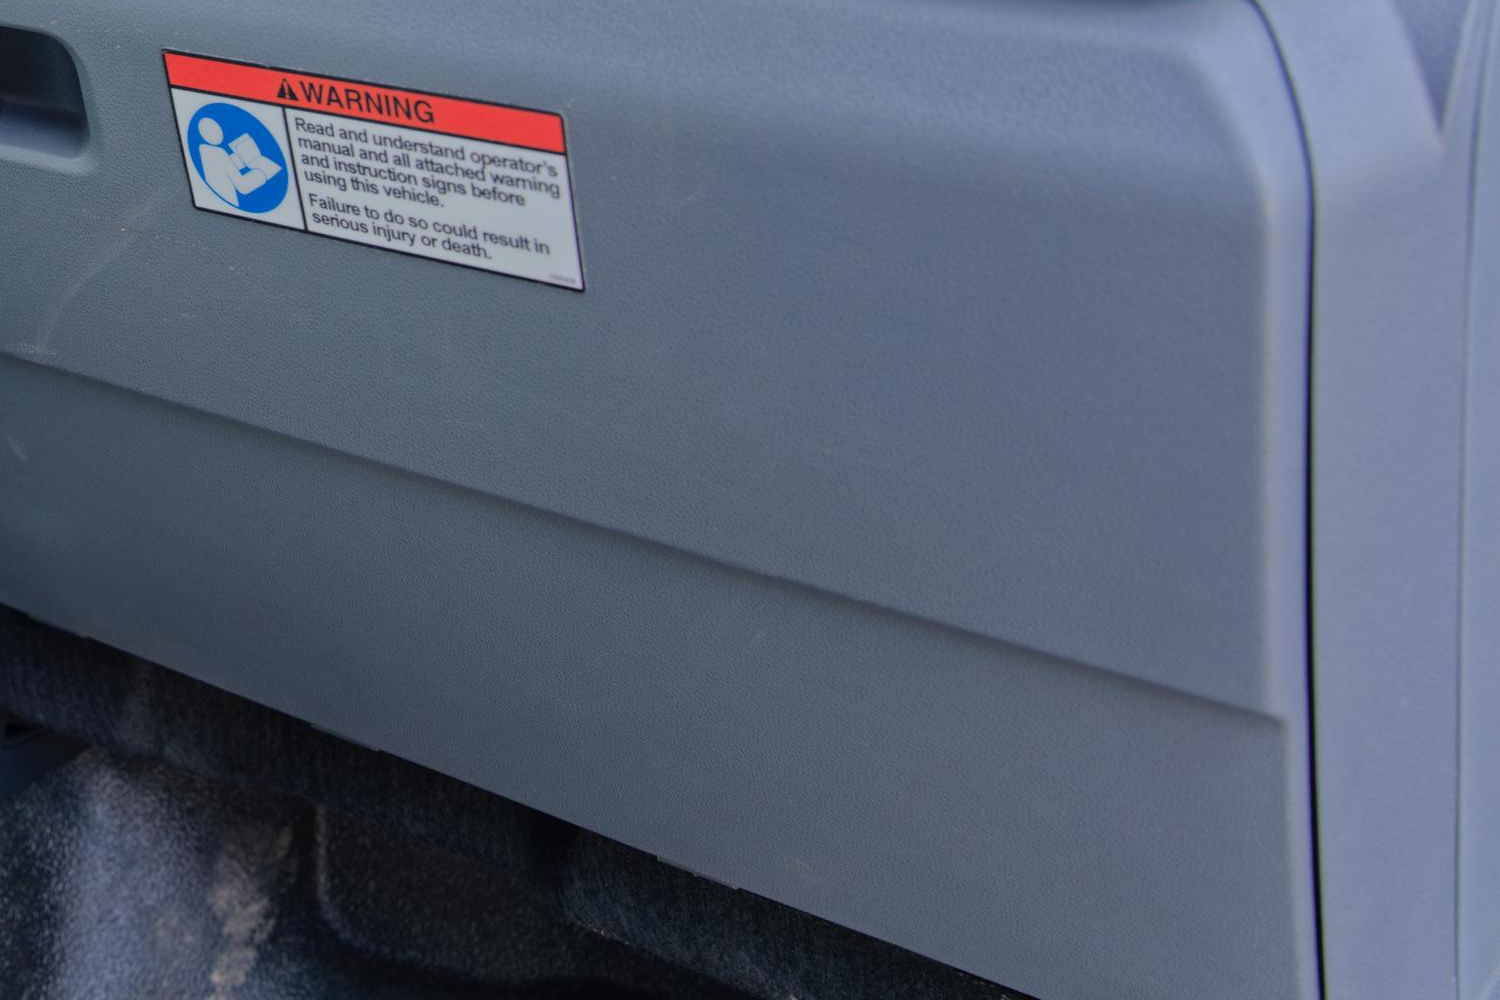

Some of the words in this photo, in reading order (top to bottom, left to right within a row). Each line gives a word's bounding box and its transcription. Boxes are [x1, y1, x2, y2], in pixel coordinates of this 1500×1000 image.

[300, 80, 435, 124] WARNING
[295, 117, 335, 137] Read
[339, 128, 369, 143] and
[372, 133, 466, 161] understand
[470, 152, 558, 177] operator's
[297, 137, 355, 157] manual
[359, 148, 389, 164] and
[393, 153, 411, 168] all
[415, 157, 486, 181] attached
[490, 171, 560, 199] warning
[301, 154, 330, 169] and
[334, 156, 418, 186] instruction
[422, 174, 468, 195] signs
[471, 182, 525, 206] before
[304, 170, 347, 191] using
[350, 177, 379, 195] this
[382, 185, 444, 208] vehicle.
[308, 193, 361, 216] Failure
[364, 205, 380, 220] to
[384, 208, 405, 225] do
[408, 215, 429, 230] so
[432, 221, 478, 240] could
[482, 230, 531, 252] result
[534, 237, 551, 255] in
[312, 212, 369, 234] serious
[372, 221, 416, 247] injury
[420, 234, 438, 247] or
[441, 236, 493, 260] death.
